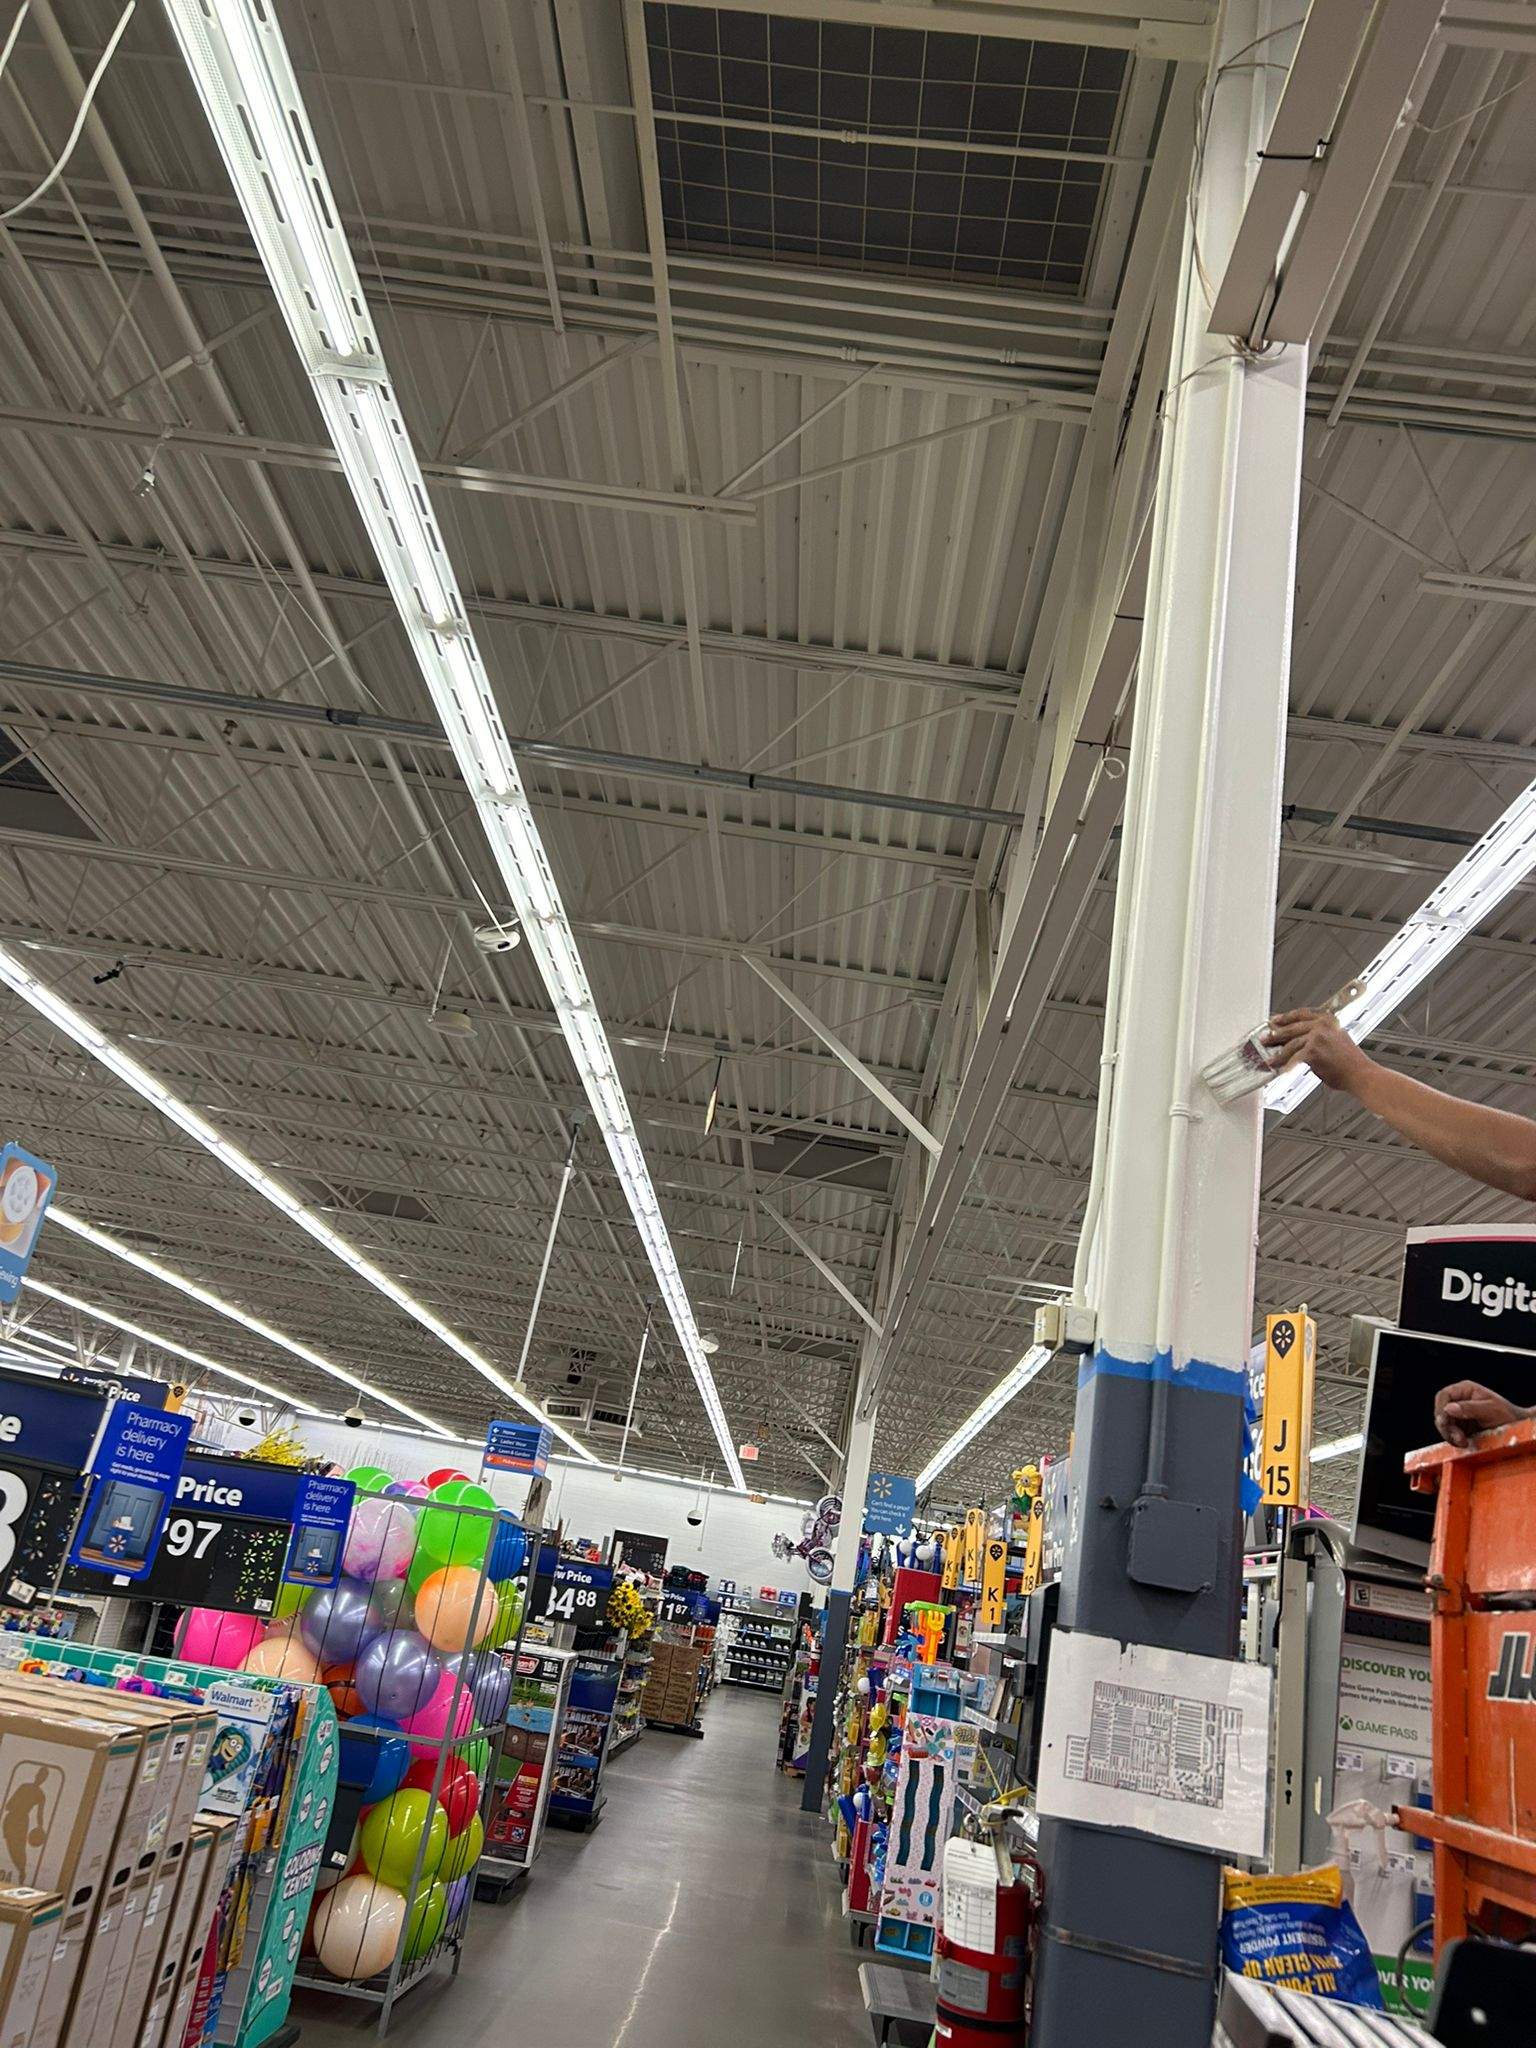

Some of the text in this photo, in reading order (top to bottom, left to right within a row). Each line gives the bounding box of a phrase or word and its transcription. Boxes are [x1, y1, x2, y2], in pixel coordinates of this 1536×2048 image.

[126, 1411, 182, 1438] Pharmacy
[121, 1428, 167, 1451] delivery
[1273, 1419, 1287, 1452] J
[115, 1443, 155, 1463] is here
[308, 1479, 349, 1496] Pharmacy
[1266, 1465, 1291, 1496] 15
[175, 1476, 243, 1507] Price
[304, 1491, 339, 1505] delivery
[310, 1502, 331, 1514] here
[967, 1548, 974, 1561] K
[1028, 1551, 1036, 1568] J
[946, 1560, 953, 1573] K
[968, 1566, 973, 1578] 2
[566, 1570, 592, 1584] Price
[944, 1575, 949, 1586] 3
[1024, 1575, 1034, 1591] 18
[987, 1587, 999, 1602] K
[989, 1607, 995, 1621] 1
[1341, 1657, 1406, 1679] DISCOVER
[1357, 1684, 1374, 1693] Game
[211, 1689, 253, 1708] Walmart
[1369, 1696, 1382, 1704] play
[1355, 1720, 1419, 1741] GAME PASS
[284, 1843, 323, 1880] COLORING
[283, 1866, 314, 1899] CENTER
[1239, 1934, 1280, 1954] POWDER
[1264, 1951, 1312, 1977] CLEAN
